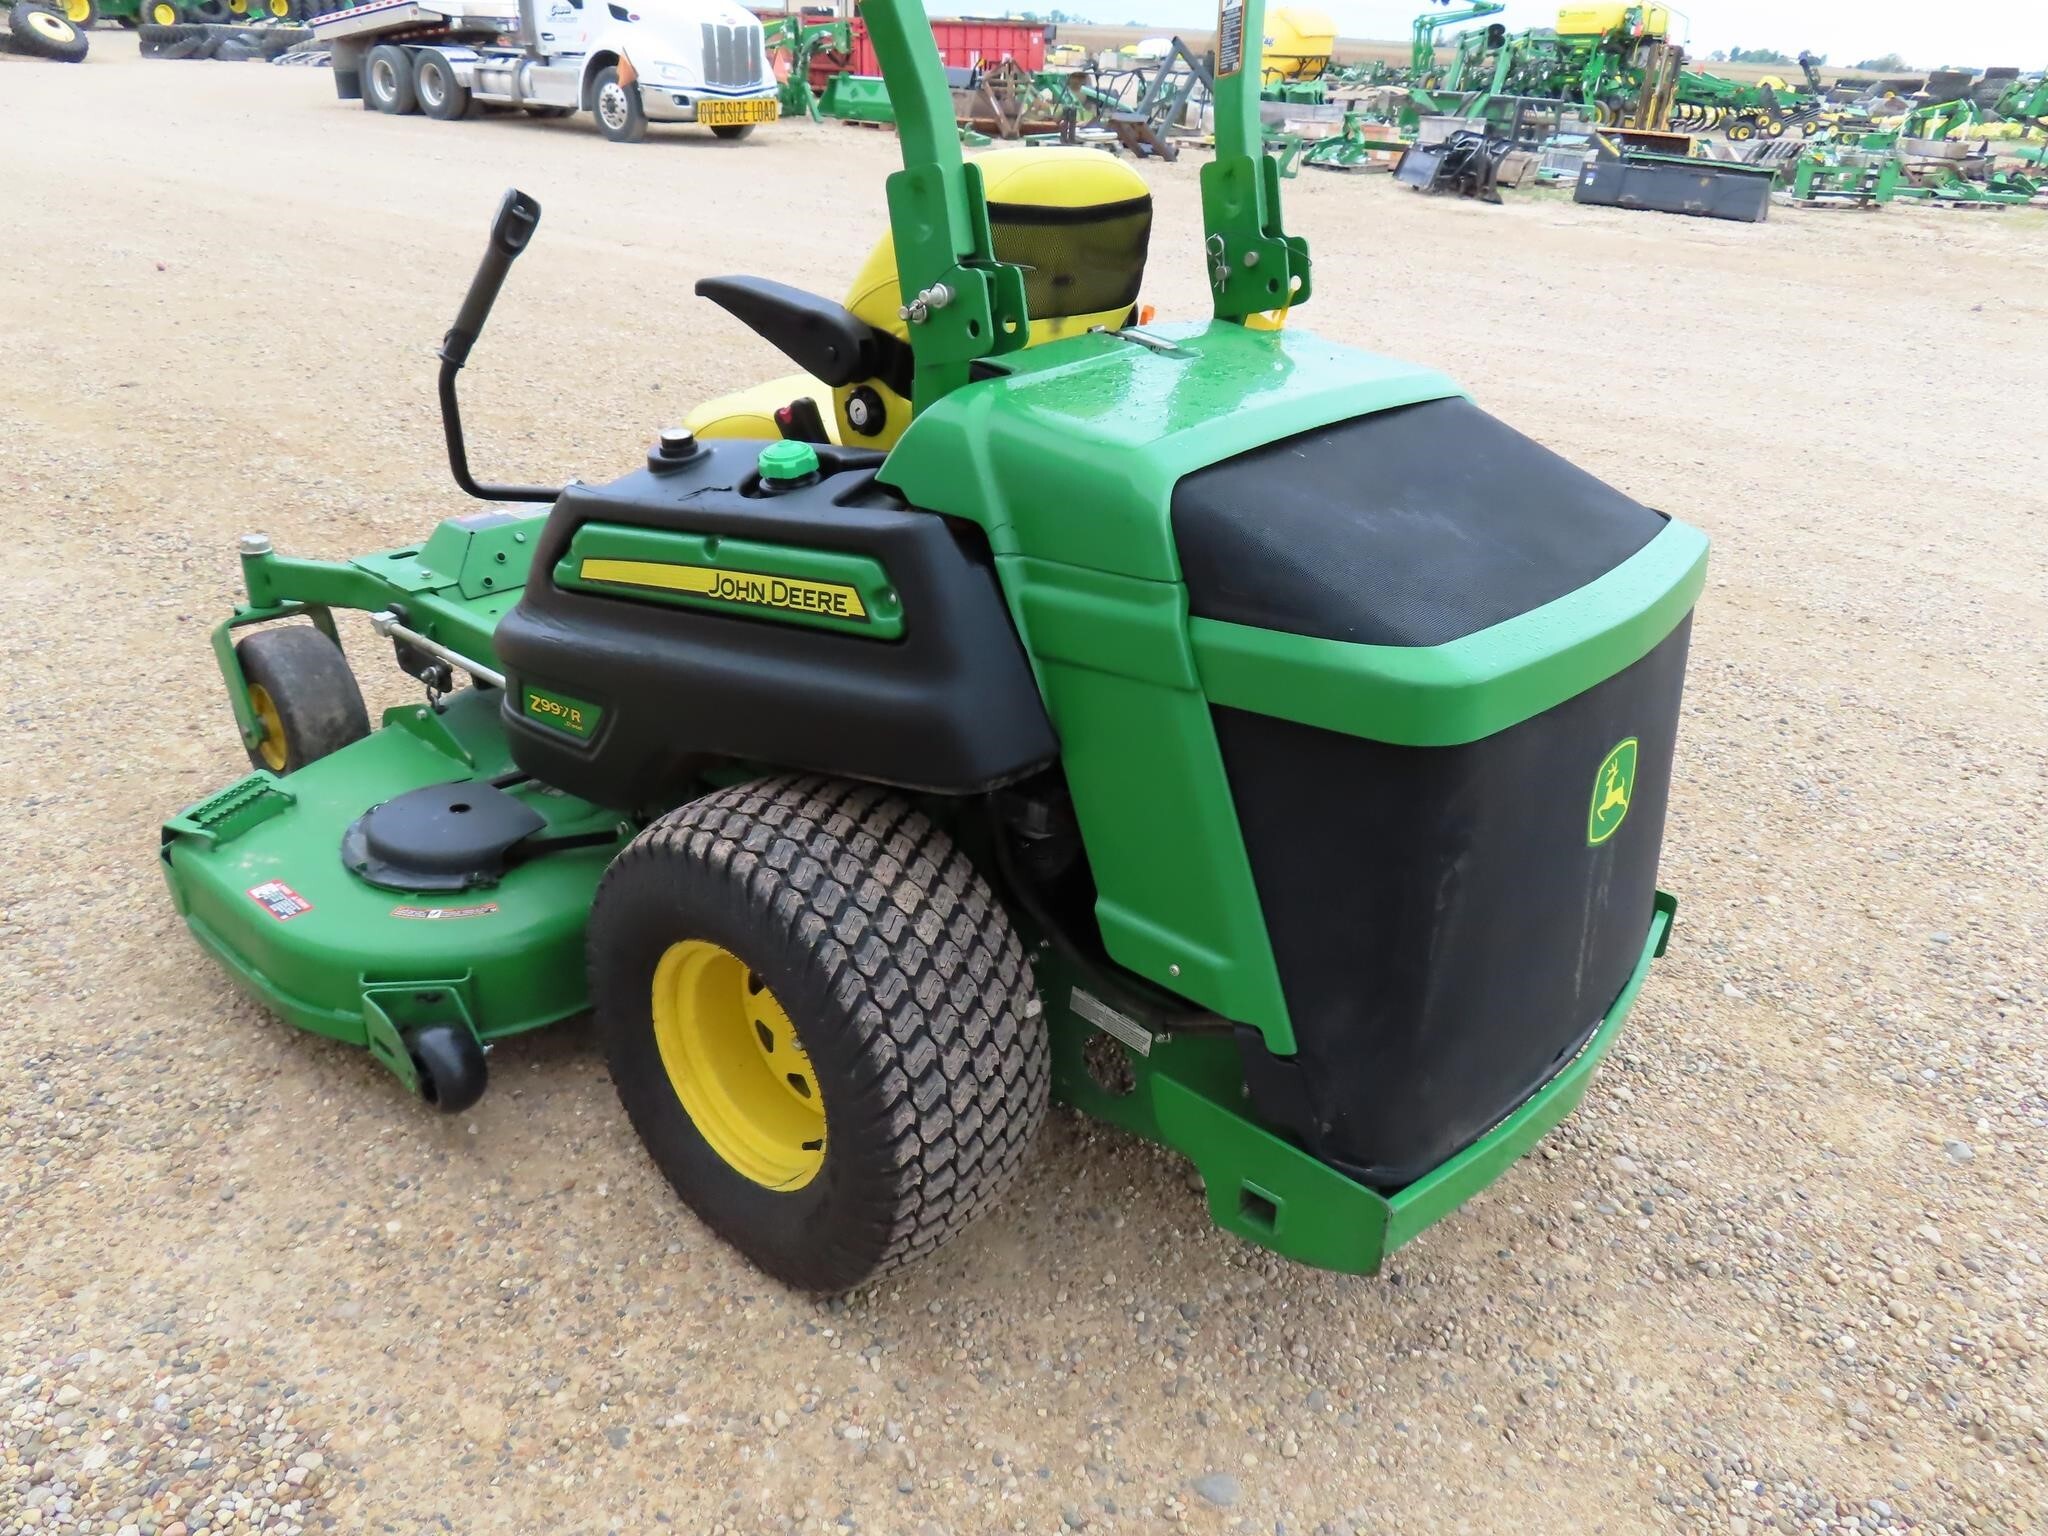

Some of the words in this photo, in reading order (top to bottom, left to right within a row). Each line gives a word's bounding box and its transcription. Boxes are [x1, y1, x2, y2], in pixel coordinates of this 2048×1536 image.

[701, 102, 748, 123] OVERSIZE
[753, 101, 776, 122] LOAD
[708, 573, 765, 601] JOHN
[772, 580, 847, 613] DEERE
